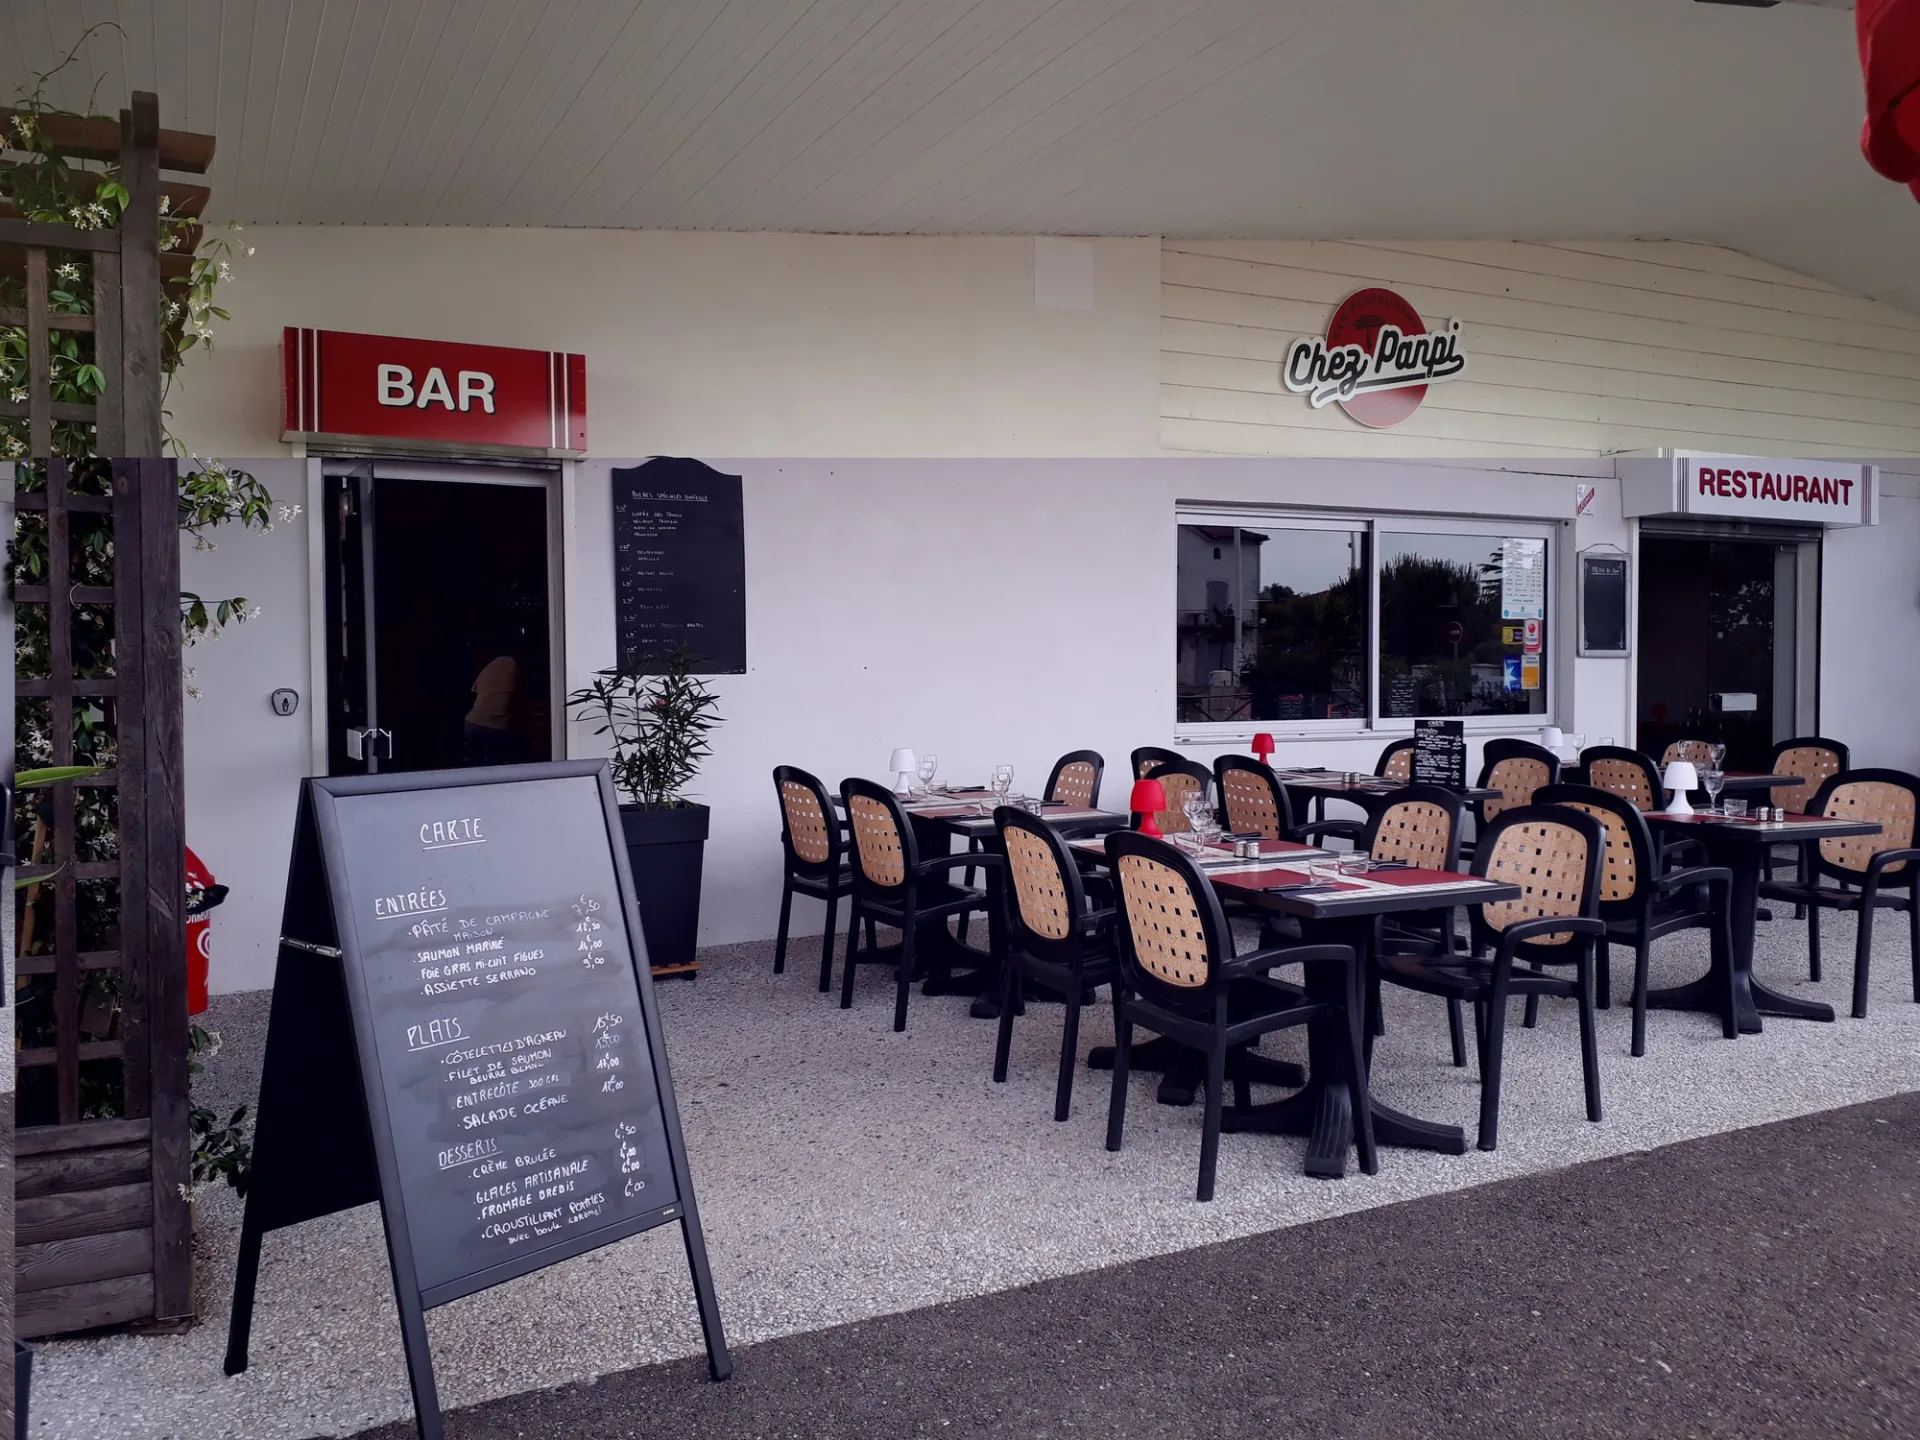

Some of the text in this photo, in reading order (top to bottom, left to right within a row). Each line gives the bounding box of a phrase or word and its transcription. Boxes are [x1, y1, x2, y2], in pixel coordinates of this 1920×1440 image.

[1290, 322, 1464, 395] Chez Panpi
[377, 363, 495, 414] BAR
[1699, 467, 1854, 506] RESTAURANT
[420, 818, 483, 844] CARTE
[375, 887, 446, 916] ENTRÉES
[412, 917, 449, 938] PÂTÉ
[459, 919, 477, 930] DE
[486, 909, 549, 926] CAMPAGNE
[418, 946, 460, 963] SAUMON
[466, 936, 504, 954] MARINÉ
[444, 961, 471, 976] GRAS
[514, 949, 545, 964] FIGUES
[424, 976, 480, 996] ASSIETTE
[486, 967, 537, 985] SERRANO
[407, 1017, 462, 1048] PLATS
[449, 1066, 479, 1082] FILET
[487, 1061, 503, 1072] DE
[512, 1049, 552, 1066] SAUMON
[470, 1070, 506, 1085] BEURRE
[456, 1081, 519, 1110] ENTRECÔTE
[463, 1106, 517, 1130] SALADE
[438, 1138, 498, 1168] DESSERTS
[476, 1182, 518, 1205] GLACES
[525, 1159, 588, 1188] ARTISANALE
[482, 1195, 532, 1220] FROMAGE
[485, 1207, 563, 1239] CROUSTILLANT
[569, 1192, 605, 1214] POMMES
[508, 1233, 530, 1244] avec
